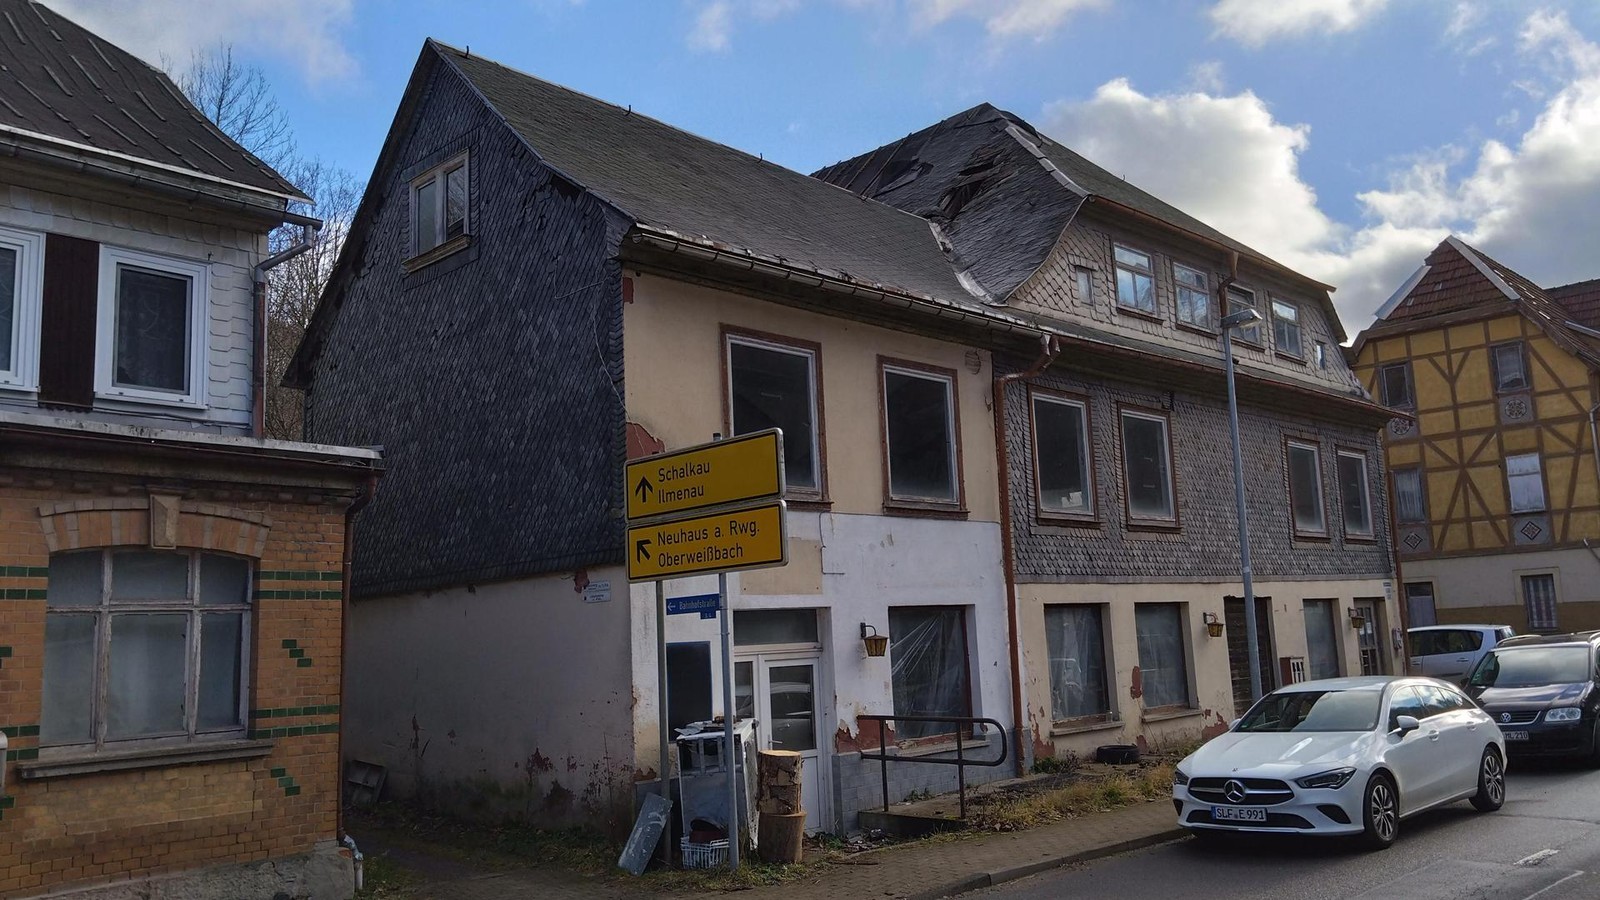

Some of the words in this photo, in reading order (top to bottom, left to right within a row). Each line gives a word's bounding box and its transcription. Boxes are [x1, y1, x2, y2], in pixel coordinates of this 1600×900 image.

[658, 462, 710, 482] Schalkau
[658, 485, 704, 504] Ilmenau
[658, 528, 708, 546] Neuhaus
[714, 526, 724, 538] a.
[729, 520, 760, 538] Rwg.
[658, 543, 743, 567] Oberweißbach
[1216, 808, 1233, 819] SLF
